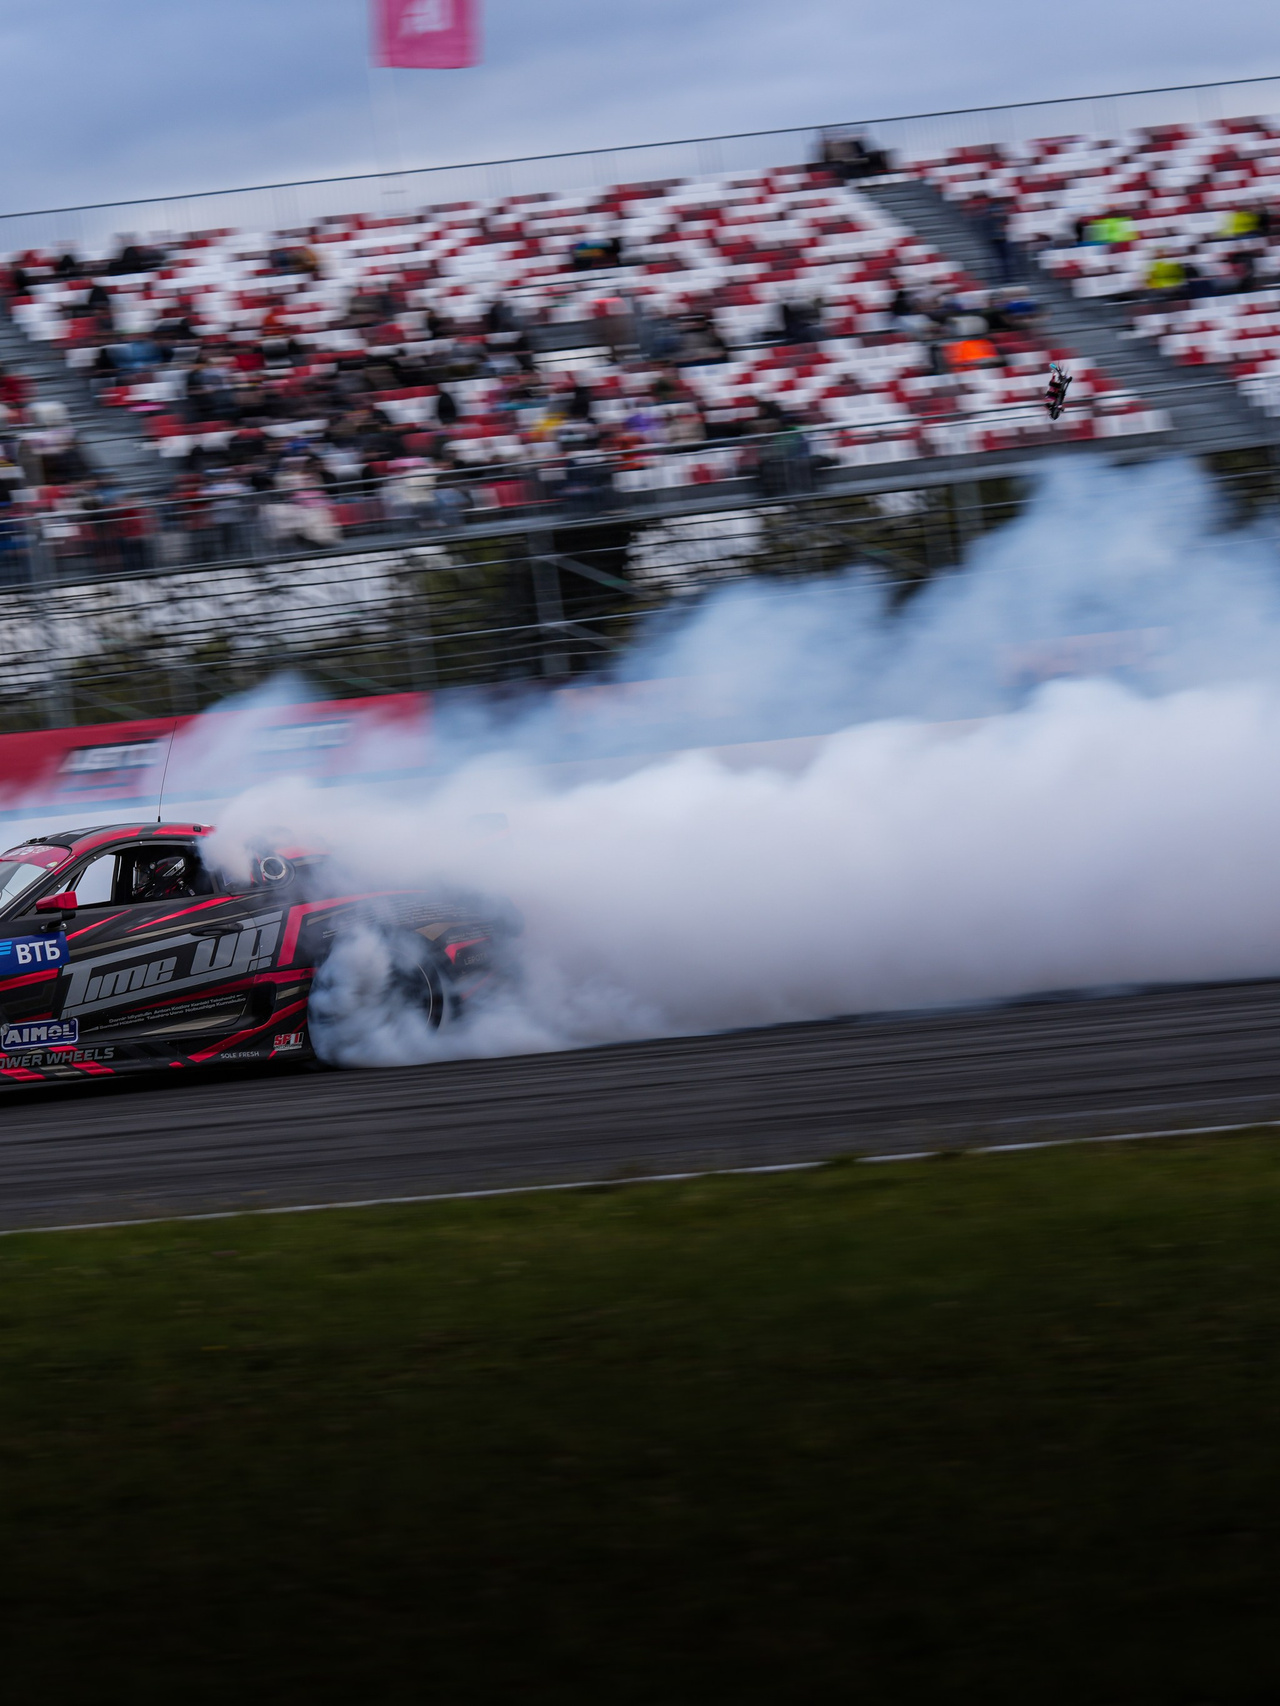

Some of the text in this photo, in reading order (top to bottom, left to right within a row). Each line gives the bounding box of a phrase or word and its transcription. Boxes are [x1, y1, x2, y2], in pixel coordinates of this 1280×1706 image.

[16, 939, 60, 964] ВТБ
[5, 1024, 74, 1044] AIMOL
[47, 1047, 114, 1064] WHEELS
